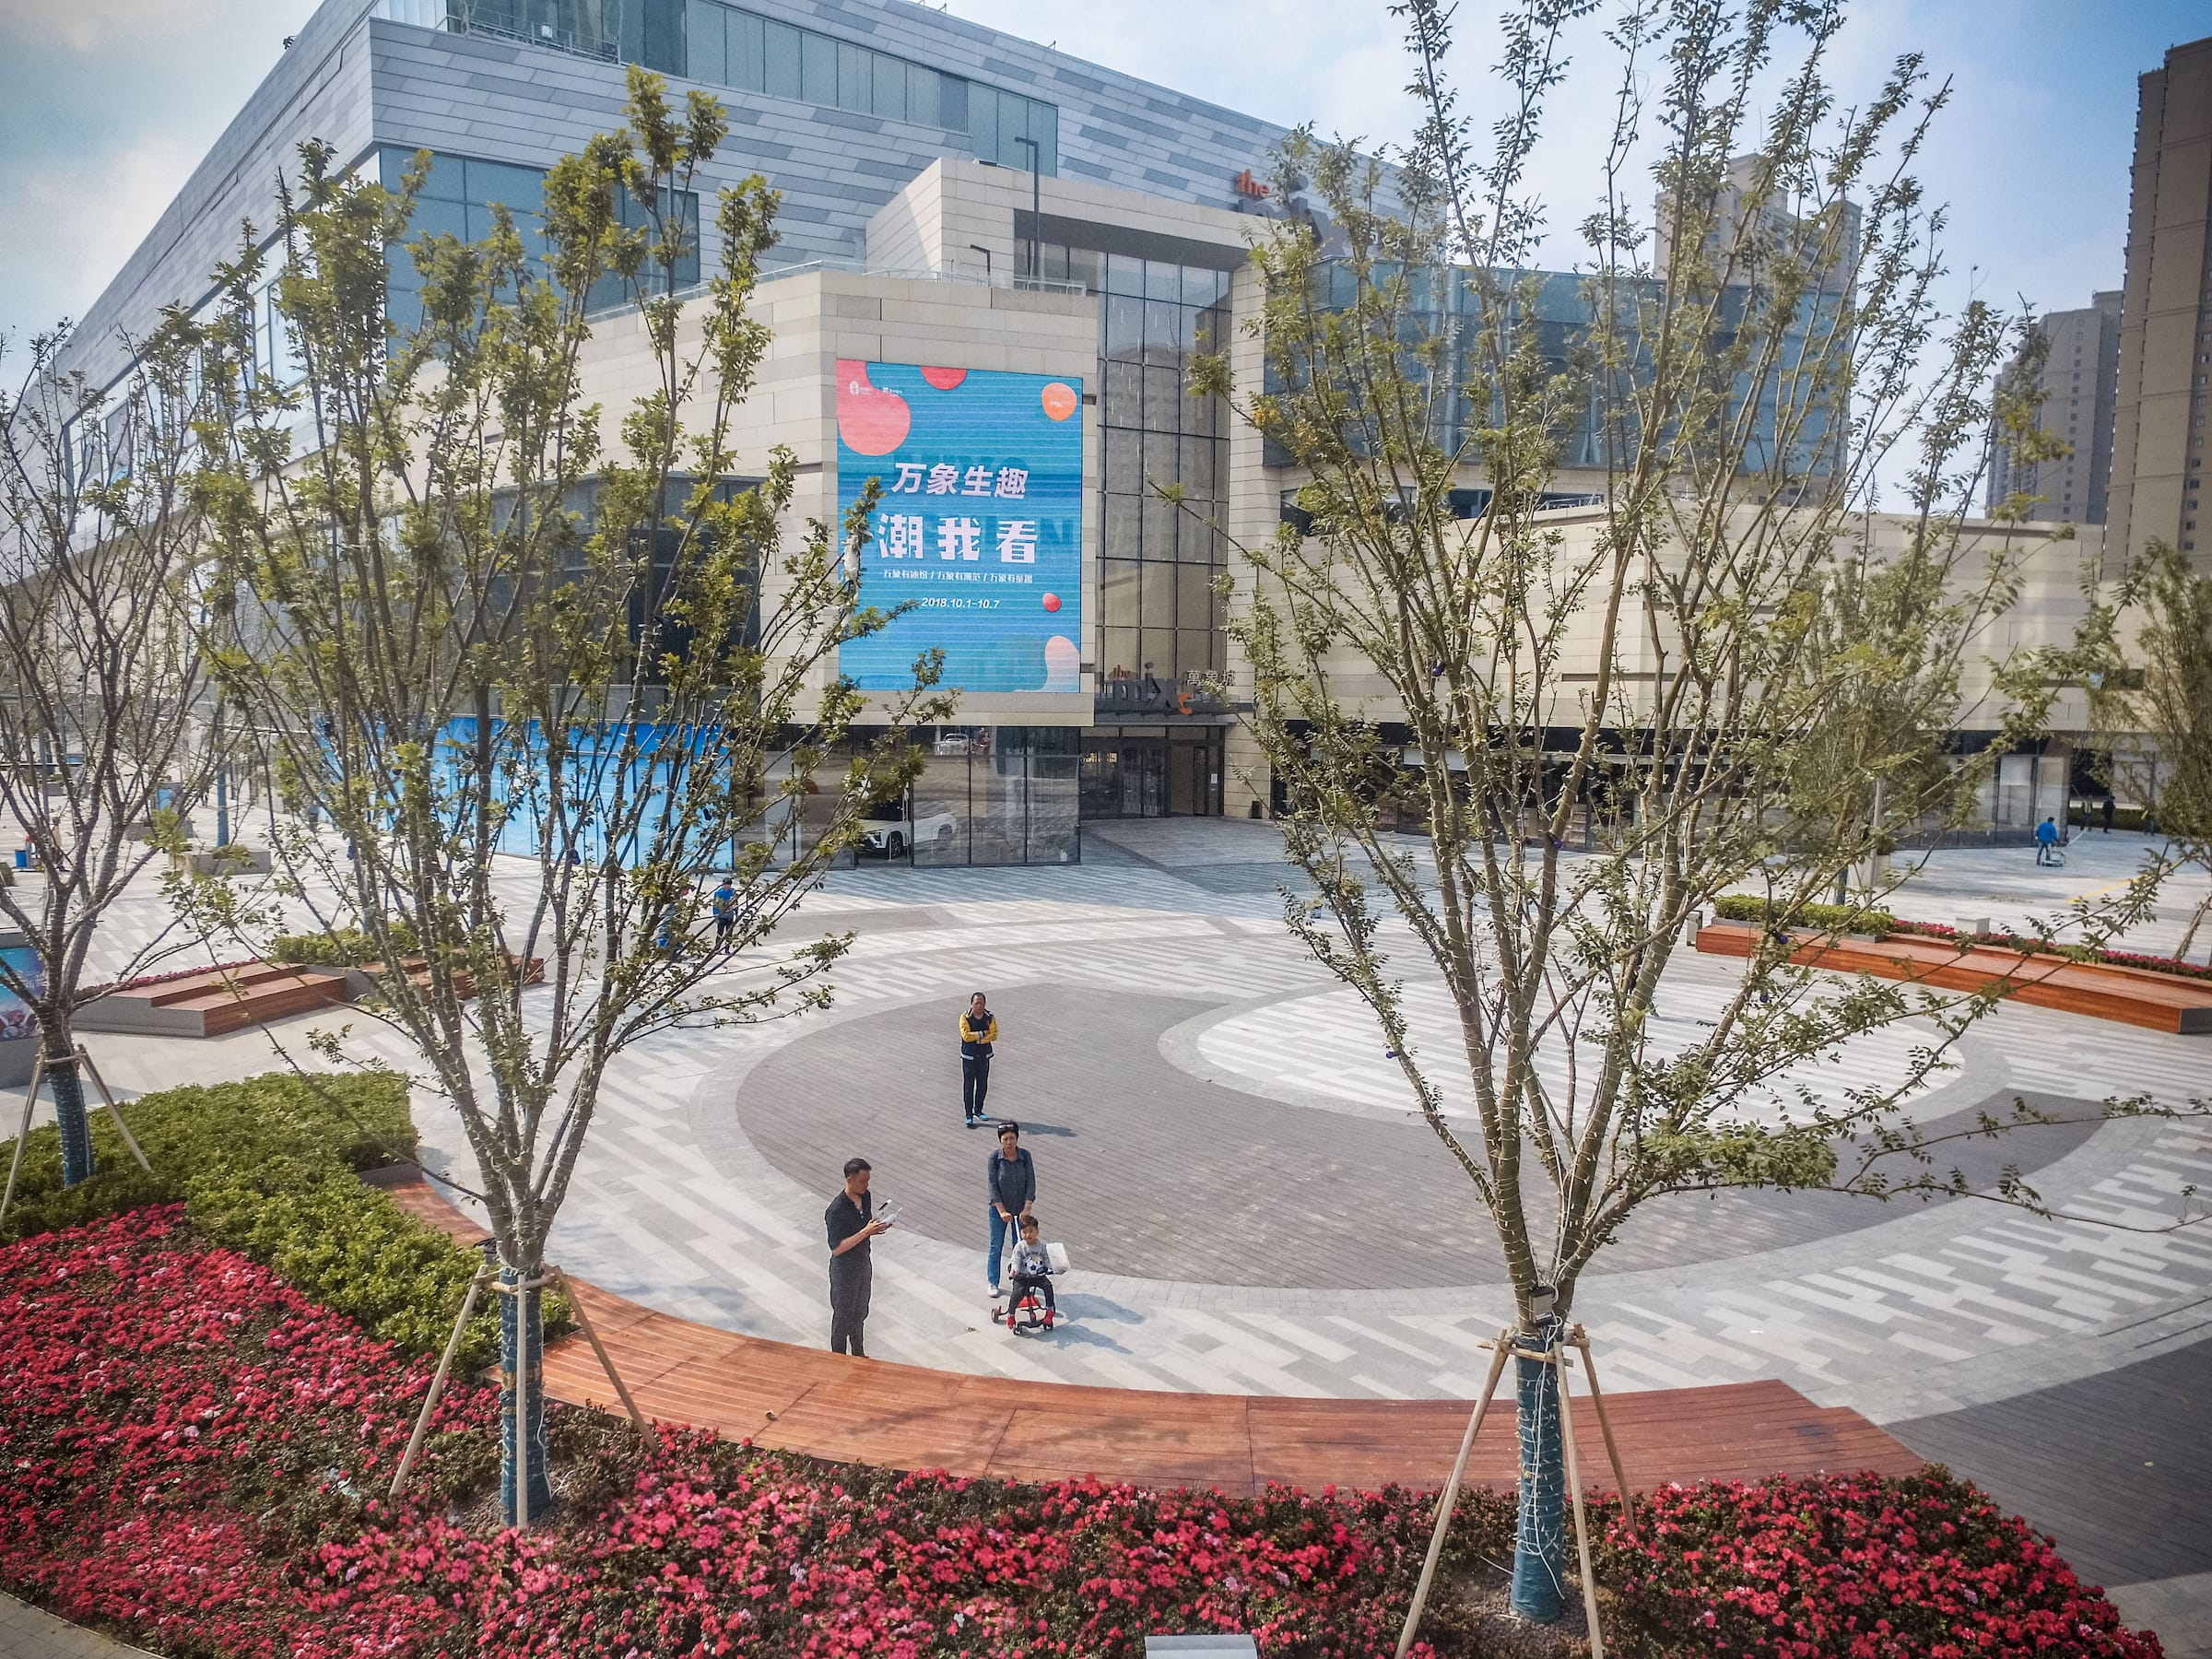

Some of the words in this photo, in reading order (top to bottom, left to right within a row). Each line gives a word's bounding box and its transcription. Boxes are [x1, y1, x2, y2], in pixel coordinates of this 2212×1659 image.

[1239, 169, 1269, 199] the
[891, 462, 1029, 500] 万象生趣
[877, 512, 1039, 564] 潮我看
[921, 597, 1000, 609] 2018.10.1-10.7
[1113, 665, 1134, 679] the
